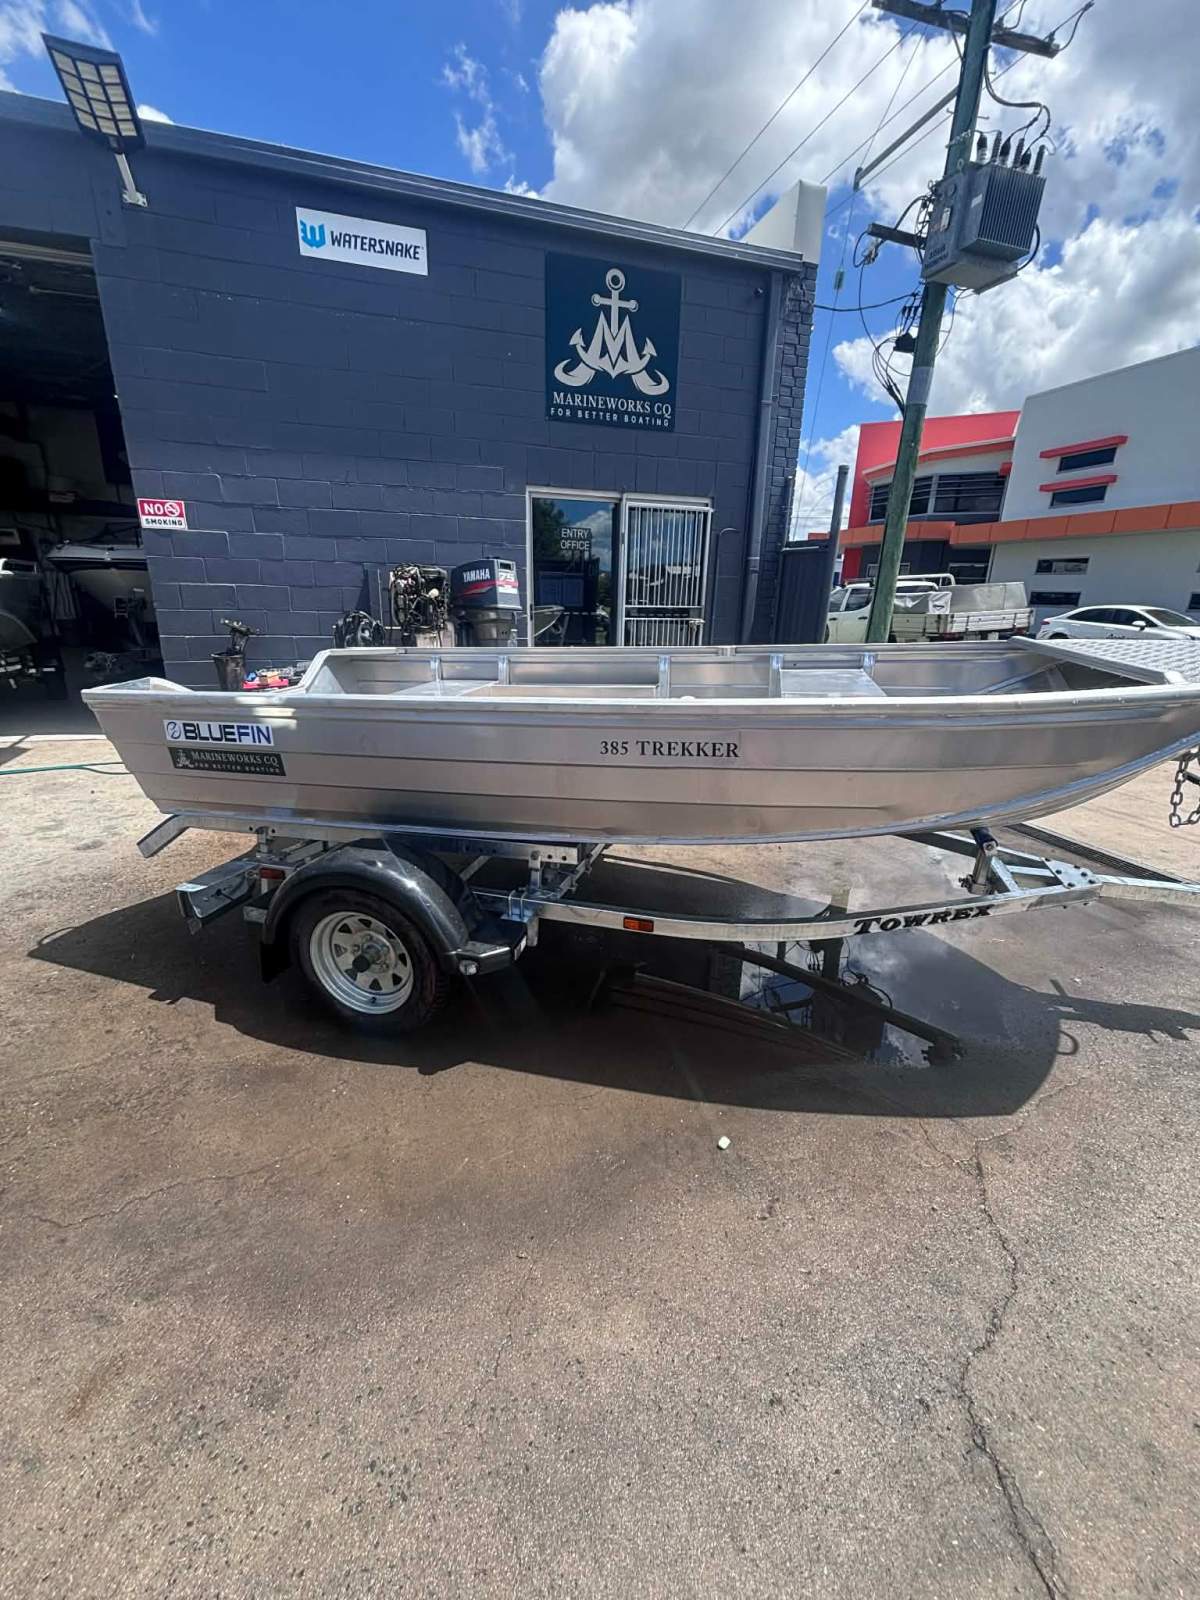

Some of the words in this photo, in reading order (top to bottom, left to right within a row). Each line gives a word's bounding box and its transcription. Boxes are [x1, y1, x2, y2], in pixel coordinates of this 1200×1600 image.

[330, 230, 421, 260] WATERSNAKE
[553, 391, 651, 413] MARINEWORKS
[654, 402, 671, 418] CQ
[550, 407, 571, 416] FOR
[577, 409, 618, 421] BETTER
[624, 415, 669, 427] BOATING
[143, 502, 164, 515] NO
[145, 518, 183, 526] SMOKING
[561, 528, 589, 539] ENTRY
[560, 540, 590, 550] OFFICE
[463, 568, 490, 583] YAMAHA
[182, 722, 272, 745] BLUEFIN
[600, 740, 629, 755] 385
[636, 740, 740, 757] TREKKER
[191, 751, 261, 764] MARINEWORKS
[263, 755, 279, 767] CQ
